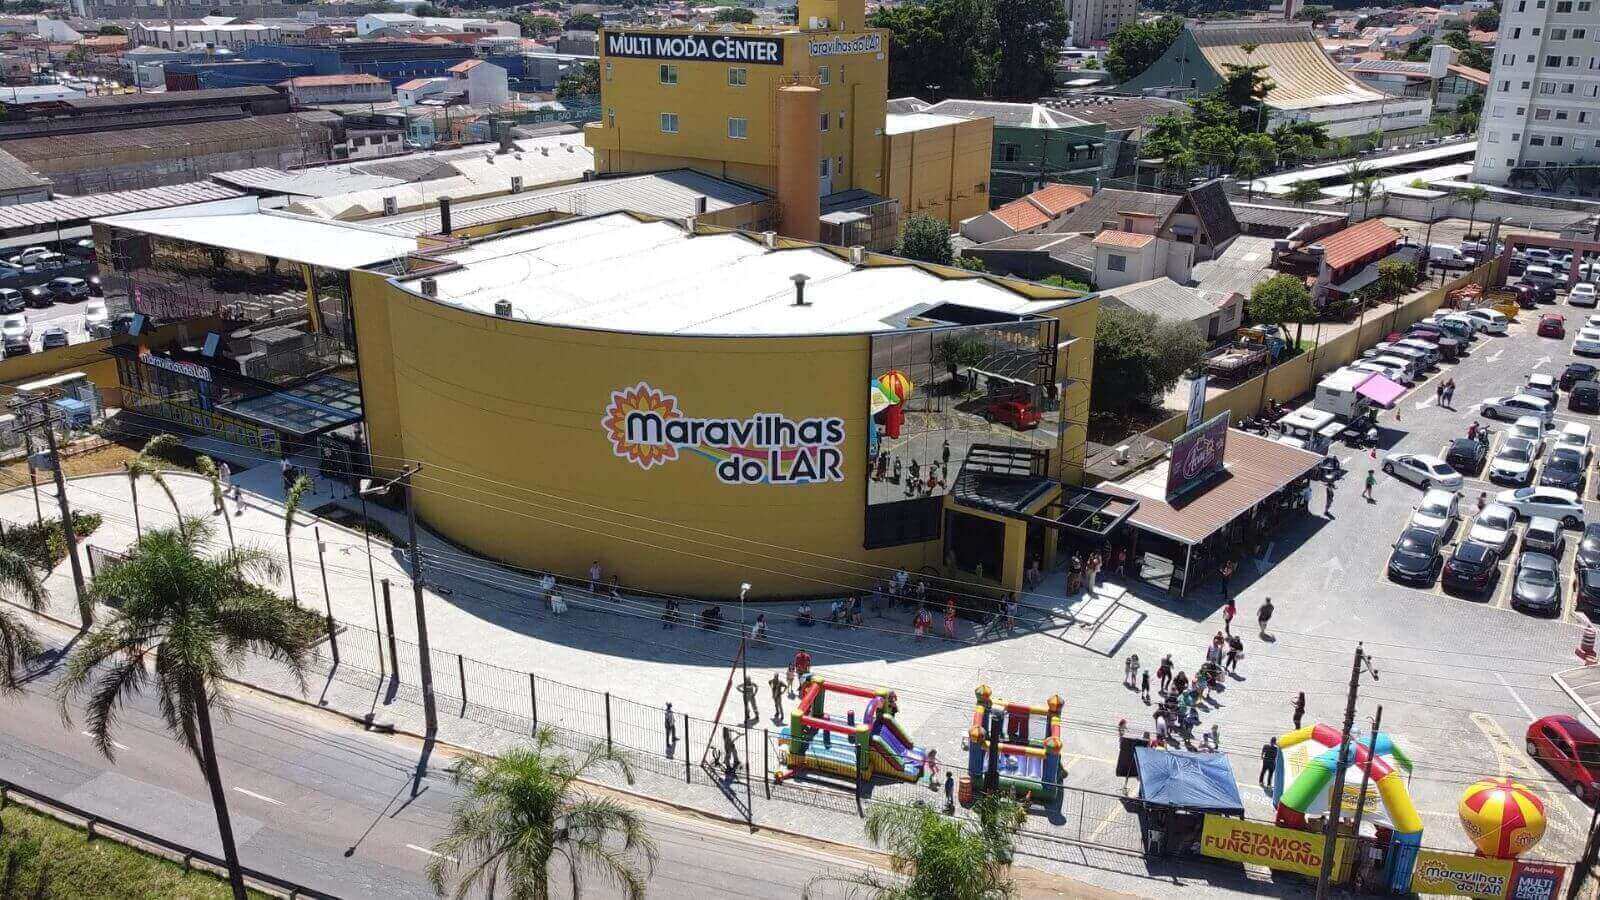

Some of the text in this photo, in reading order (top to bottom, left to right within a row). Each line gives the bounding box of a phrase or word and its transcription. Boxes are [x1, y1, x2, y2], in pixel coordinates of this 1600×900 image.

[609, 36, 778, 61] MULTI MODA CENTER
[627, 412, 843, 445] Maravilhas
[718, 449, 842, 482] do LAR
[1205, 835, 1324, 867] FUNCIONAND
[1230, 829, 1312, 854] ESTAMOS
[1457, 881, 1473, 892] do
[1475, 883, 1502, 896] LAR
[1518, 877, 1553, 889] MULTI
